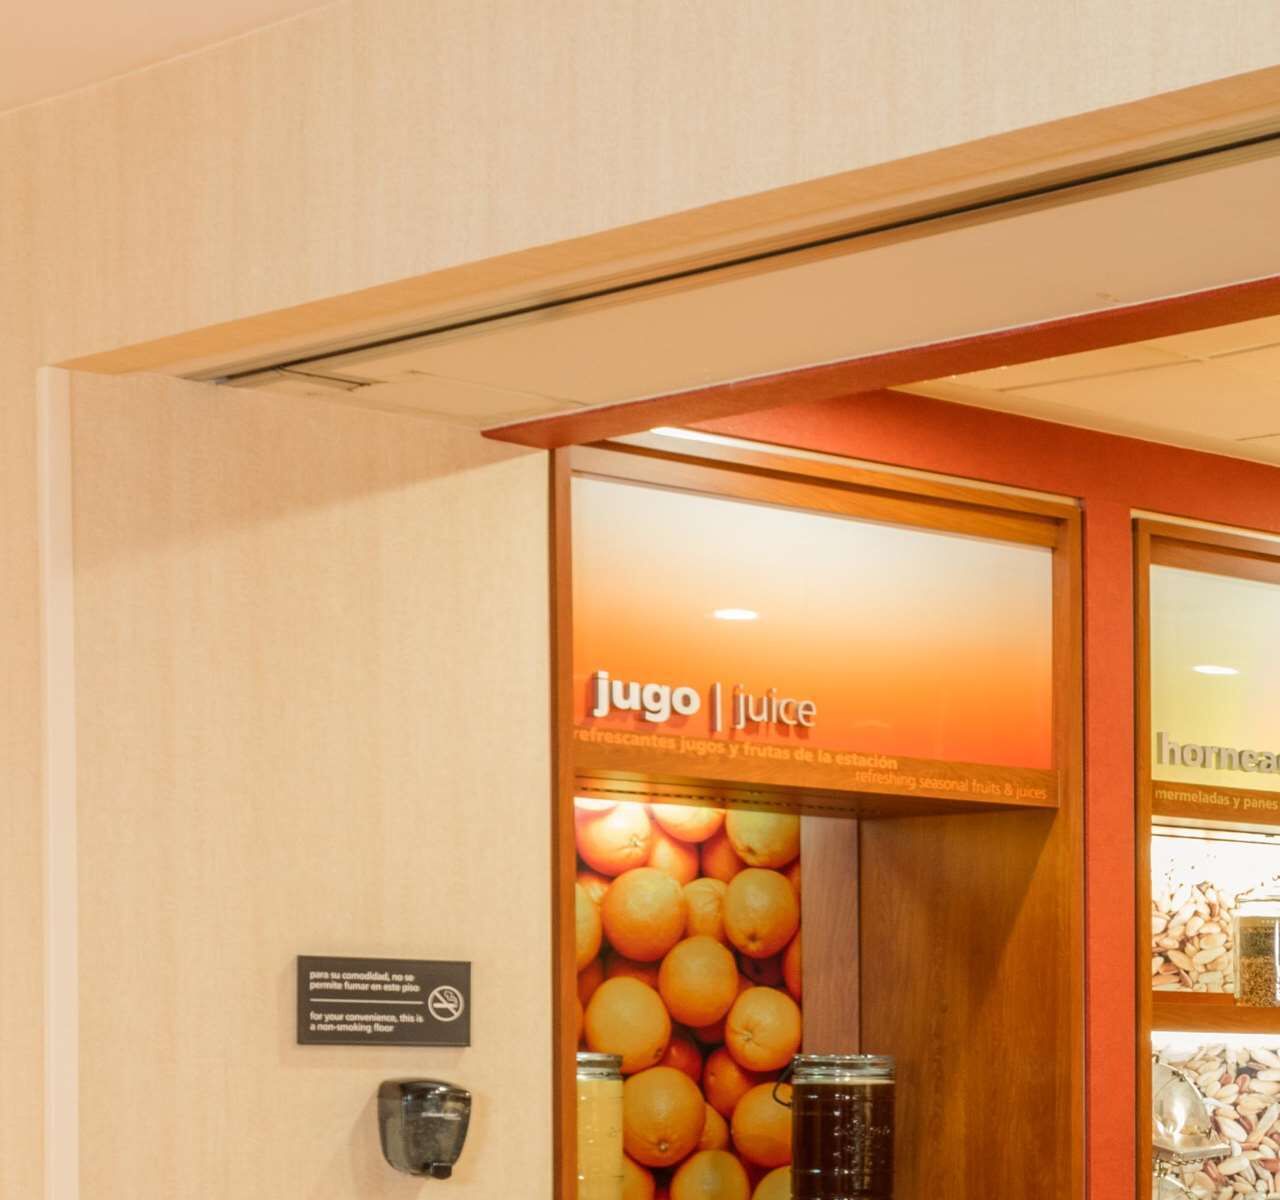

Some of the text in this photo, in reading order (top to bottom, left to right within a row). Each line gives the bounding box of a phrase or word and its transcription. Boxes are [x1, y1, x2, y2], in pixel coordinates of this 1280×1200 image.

[593, 670, 817, 730] jugo juice
[573, 727, 898, 770] refrescantes jugos y frutas de la estación
[855, 770, 916, 789] refreshing
[918, 777, 969, 791] seasonal
[971, 778, 1001, 795] fruits
[1015, 784, 1048, 800] juices
[1155, 787, 1230, 806] mermeladas
[1232, 798, 1240, 809] y
[1243, 797, 1278, 811] panes
[309, 971, 329, 979] para
[309, 981, 342, 990] permite
[344, 981, 369, 990] fumar
[383, 983, 400, 991] este
[402, 983, 420, 992] piso
[310, 1012, 322, 1021] for
[324, 1014, 344, 1022] your
[399, 1013, 415, 1022] this
[416, 1014, 424, 1023] is
[317, 1023, 372, 1033] non-smoking
[373, 1023, 394, 1032] floor
